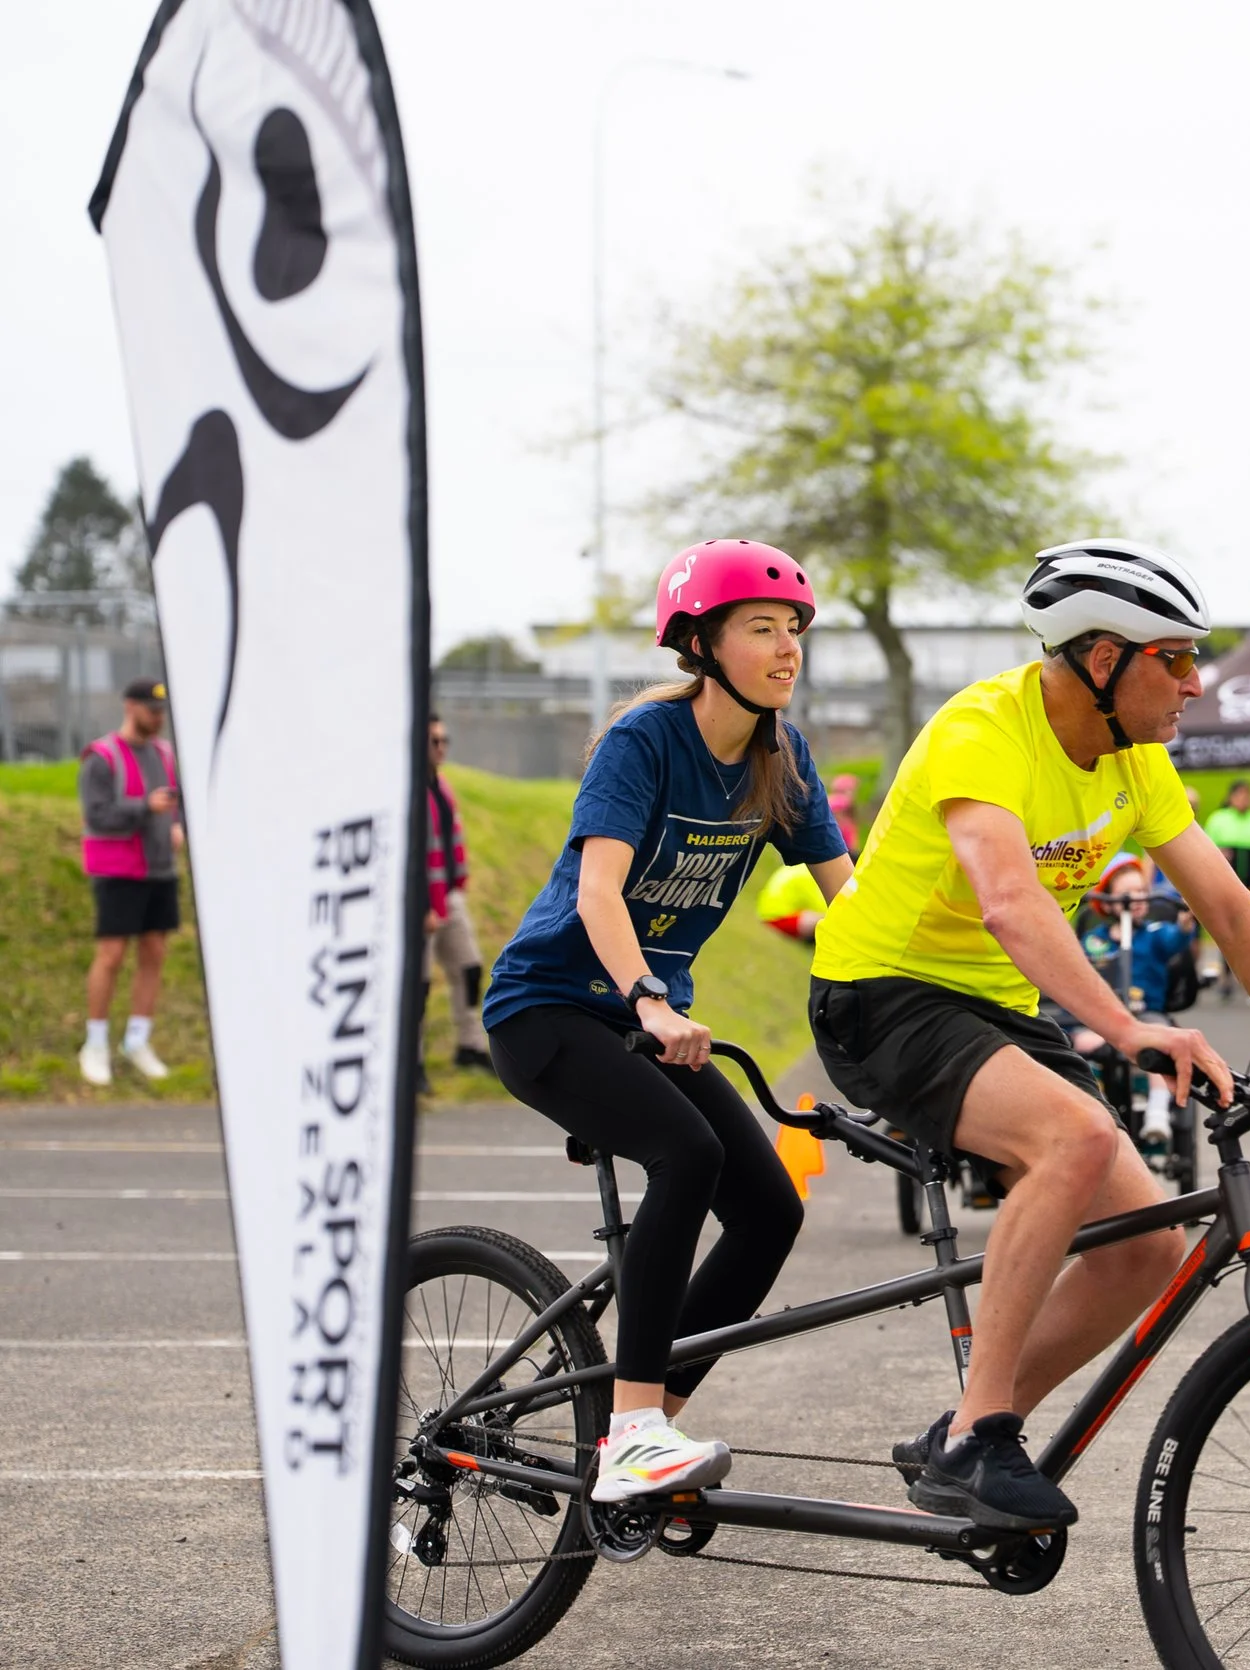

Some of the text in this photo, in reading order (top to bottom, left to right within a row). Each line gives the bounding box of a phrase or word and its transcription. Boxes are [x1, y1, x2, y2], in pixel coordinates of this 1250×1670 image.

[1096, 562, 1154, 581] BONTRAGER
[686, 832, 751, 846] HALBERG
[668, 850, 743, 880] YOUT
[286, 828, 333, 1473] NEW ZEALAND
[311, 817, 374, 1475] BLIND SPORT
[1155, 1437, 1179, 1477] BEE
[1147, 1478, 1167, 1523] LINE
